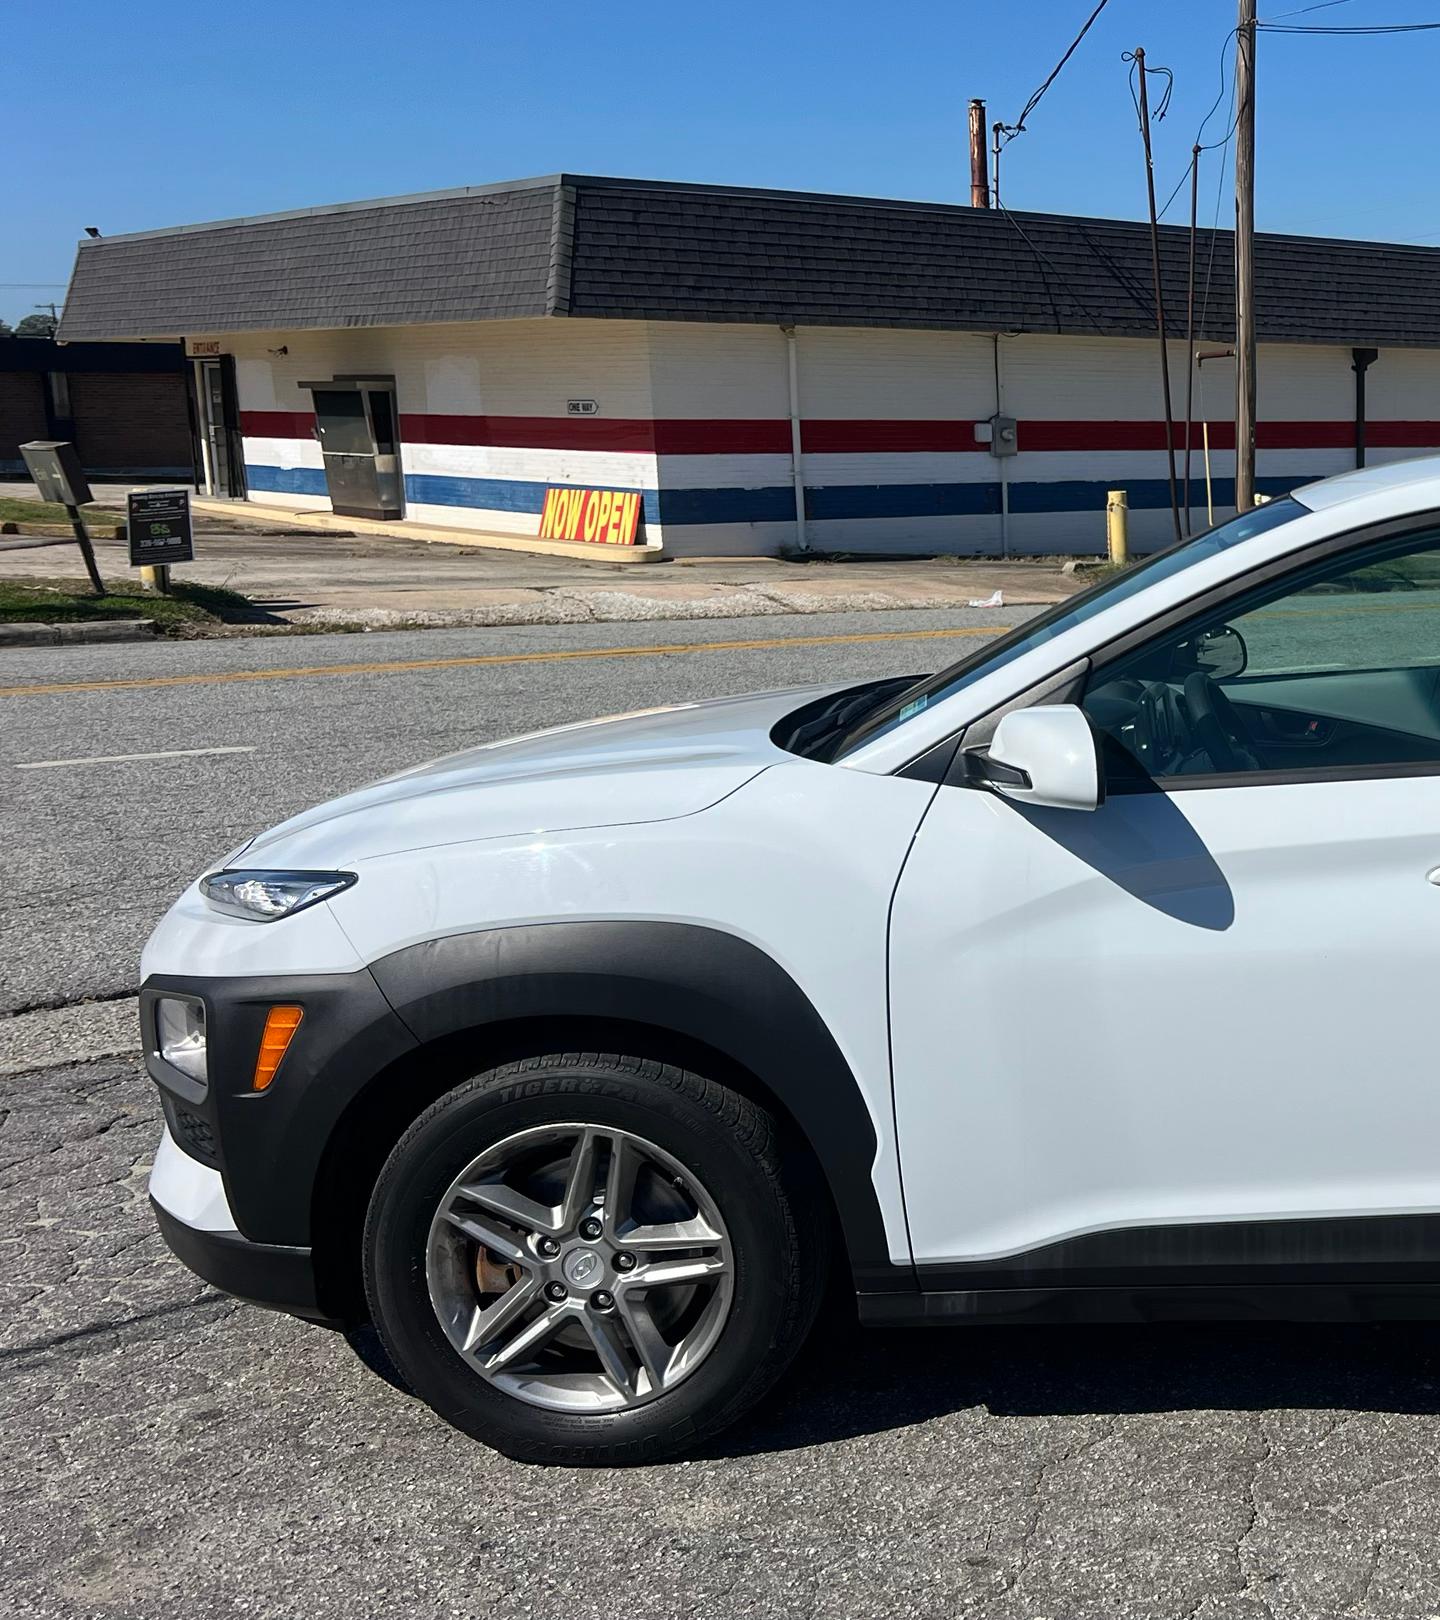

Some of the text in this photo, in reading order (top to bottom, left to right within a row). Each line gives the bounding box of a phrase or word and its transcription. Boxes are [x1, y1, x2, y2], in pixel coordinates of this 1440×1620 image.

[568, 402, 593, 412] ONE WAY
[540, 488, 638, 545] NOW OPEN
[498, 1078, 579, 1104] TIGER
